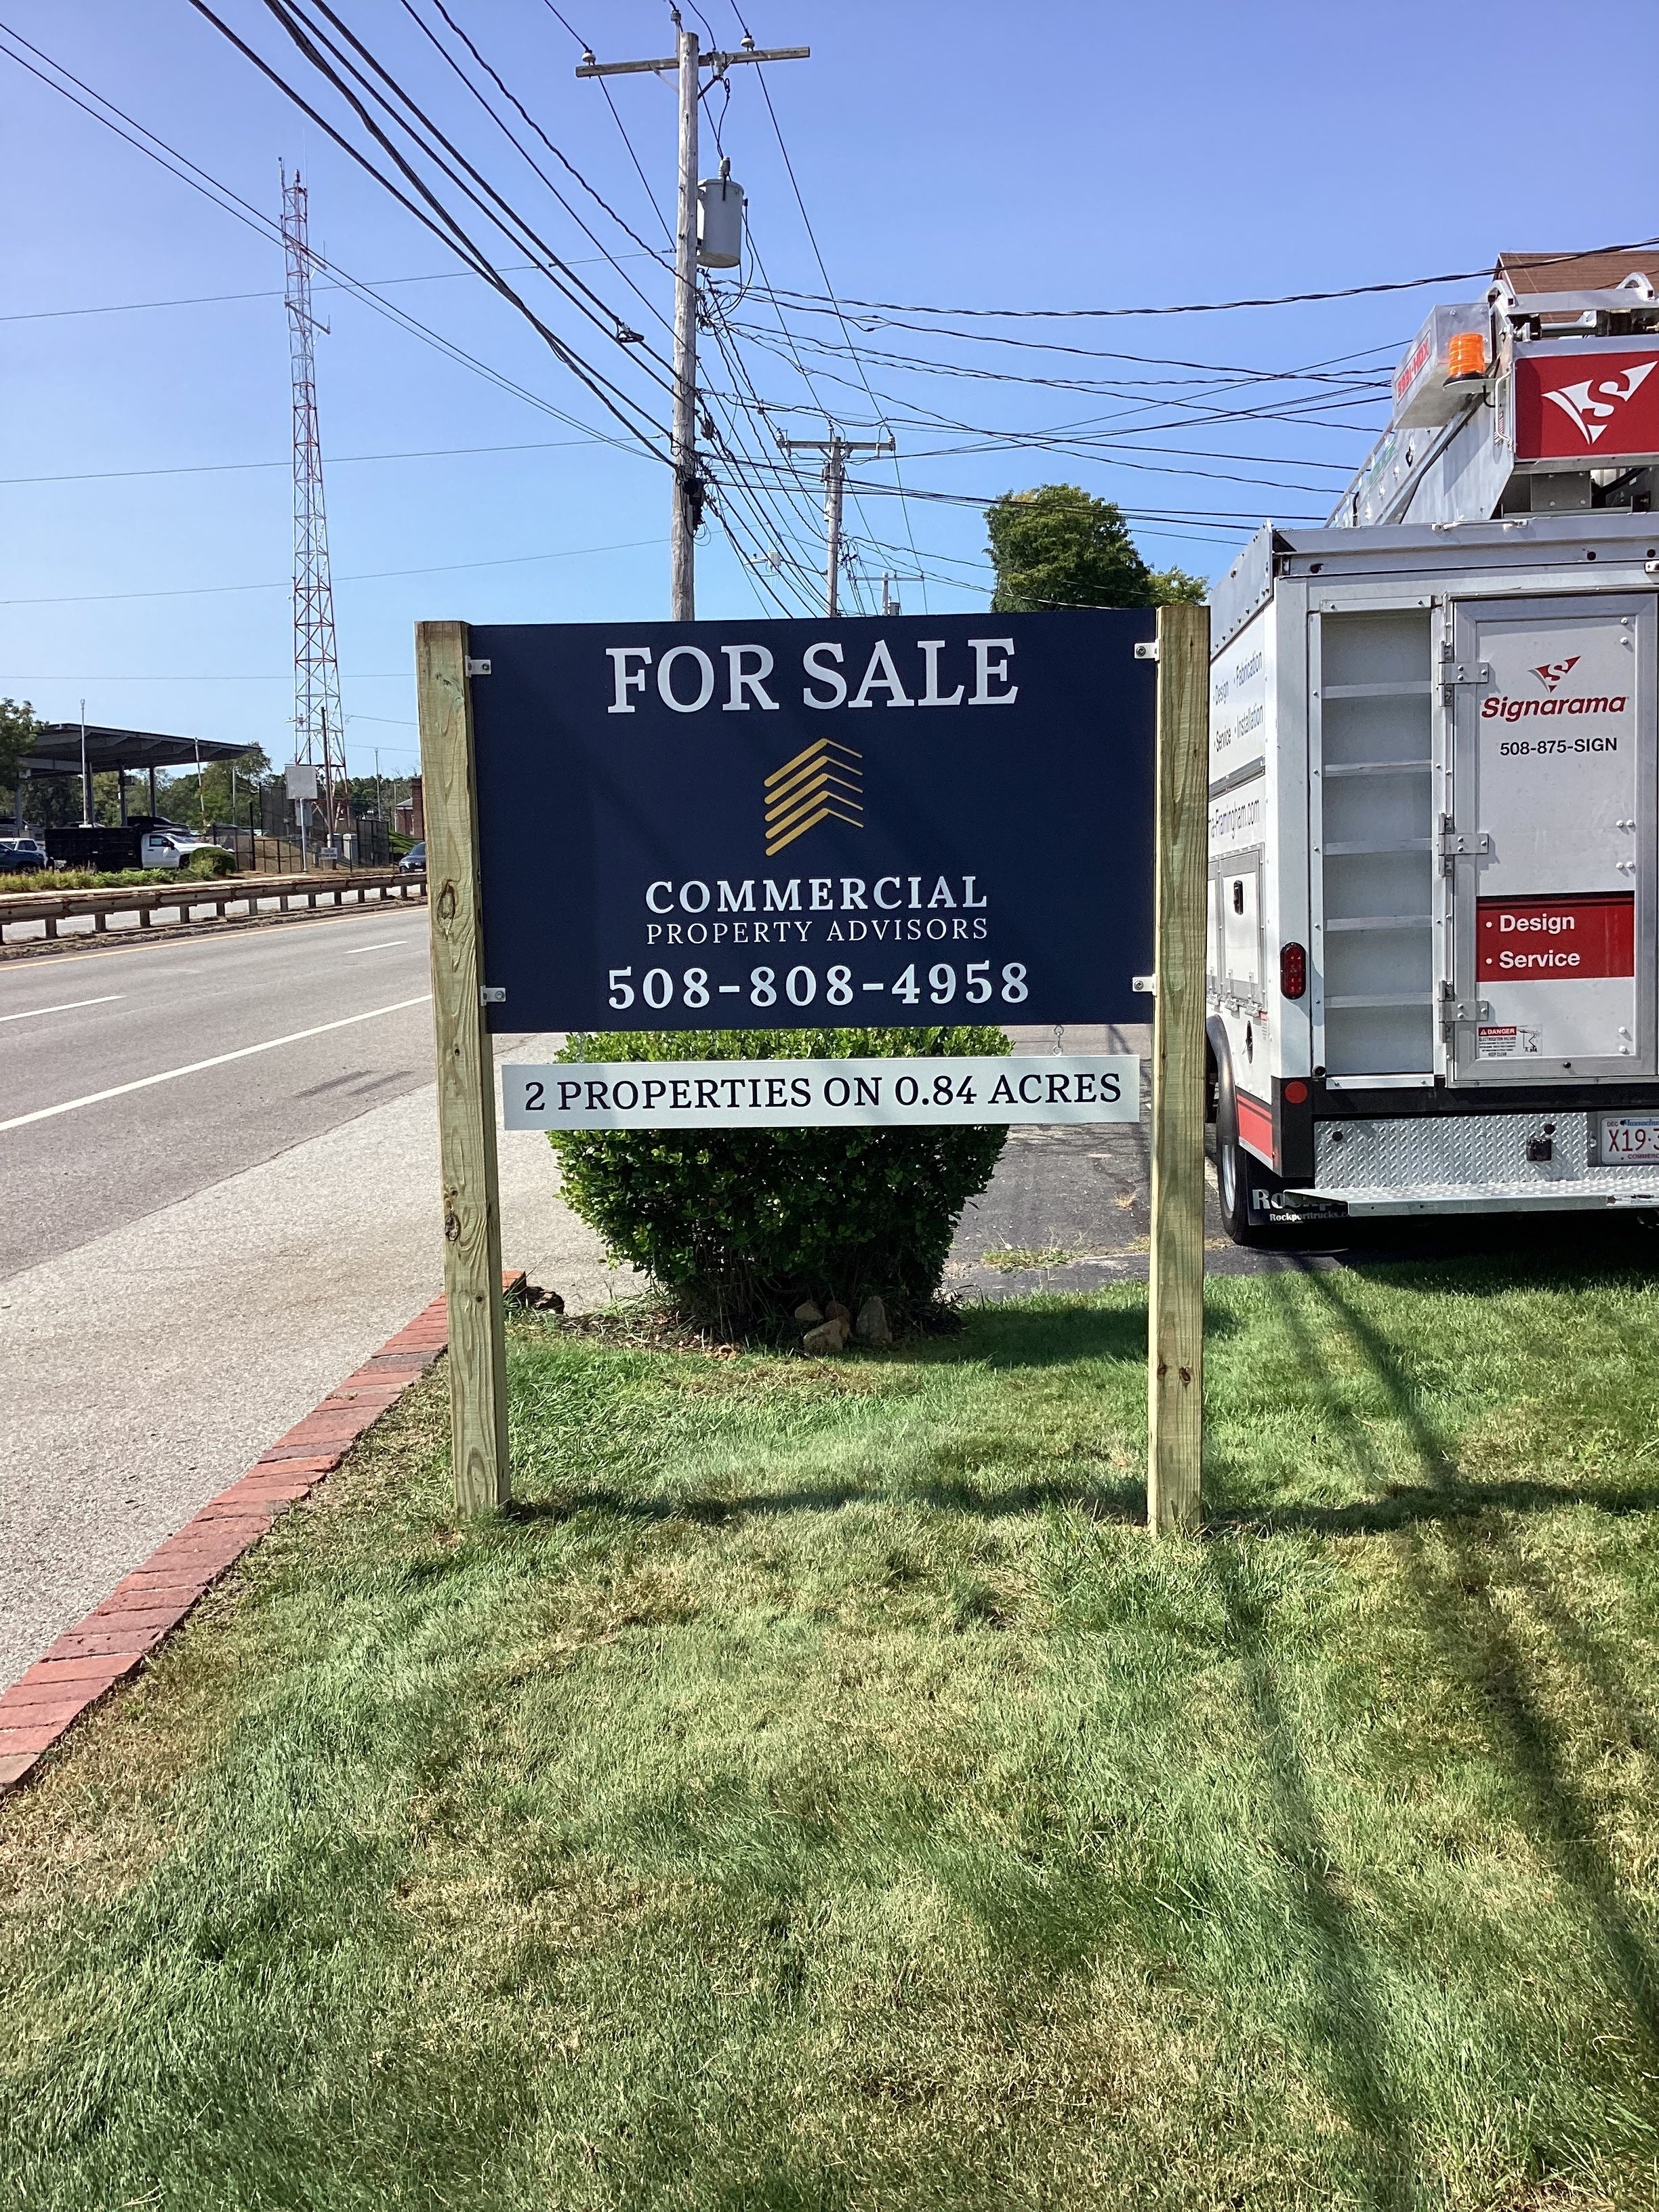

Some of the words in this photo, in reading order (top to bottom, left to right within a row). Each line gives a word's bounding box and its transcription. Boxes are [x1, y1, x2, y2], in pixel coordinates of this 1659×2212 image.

[606, 644, 779, 713] FOR
[804, 638, 1018, 710] SALE
[1215, 680, 1229, 705] Design
[1236, 651, 1263, 688] Fabrication
[1216, 725, 1231, 752] Service
[1237, 703, 1263, 739] Installation
[1481, 696, 1626, 722] Signarama
[1500, 737, 1618, 756] 508-875-SIGN
[646, 876, 986, 914] COMMERCIAL
[647, 922, 812, 945] PROPERTY
[827, 918, 987, 941] ADVISORS
[1500, 913, 1575, 935] Design
[1499, 949, 1580, 969] Service
[609, 960, 1029, 1010] 508-808-4958
[526, 1082, 546, 1111] 2
[556, 1078, 811, 1110] PROPERTIES
[823, 1077, 882, 1106] ON
[895, 1076, 977, 1106] 0.84
[987, 1073, 1121, 1104] ACRES
